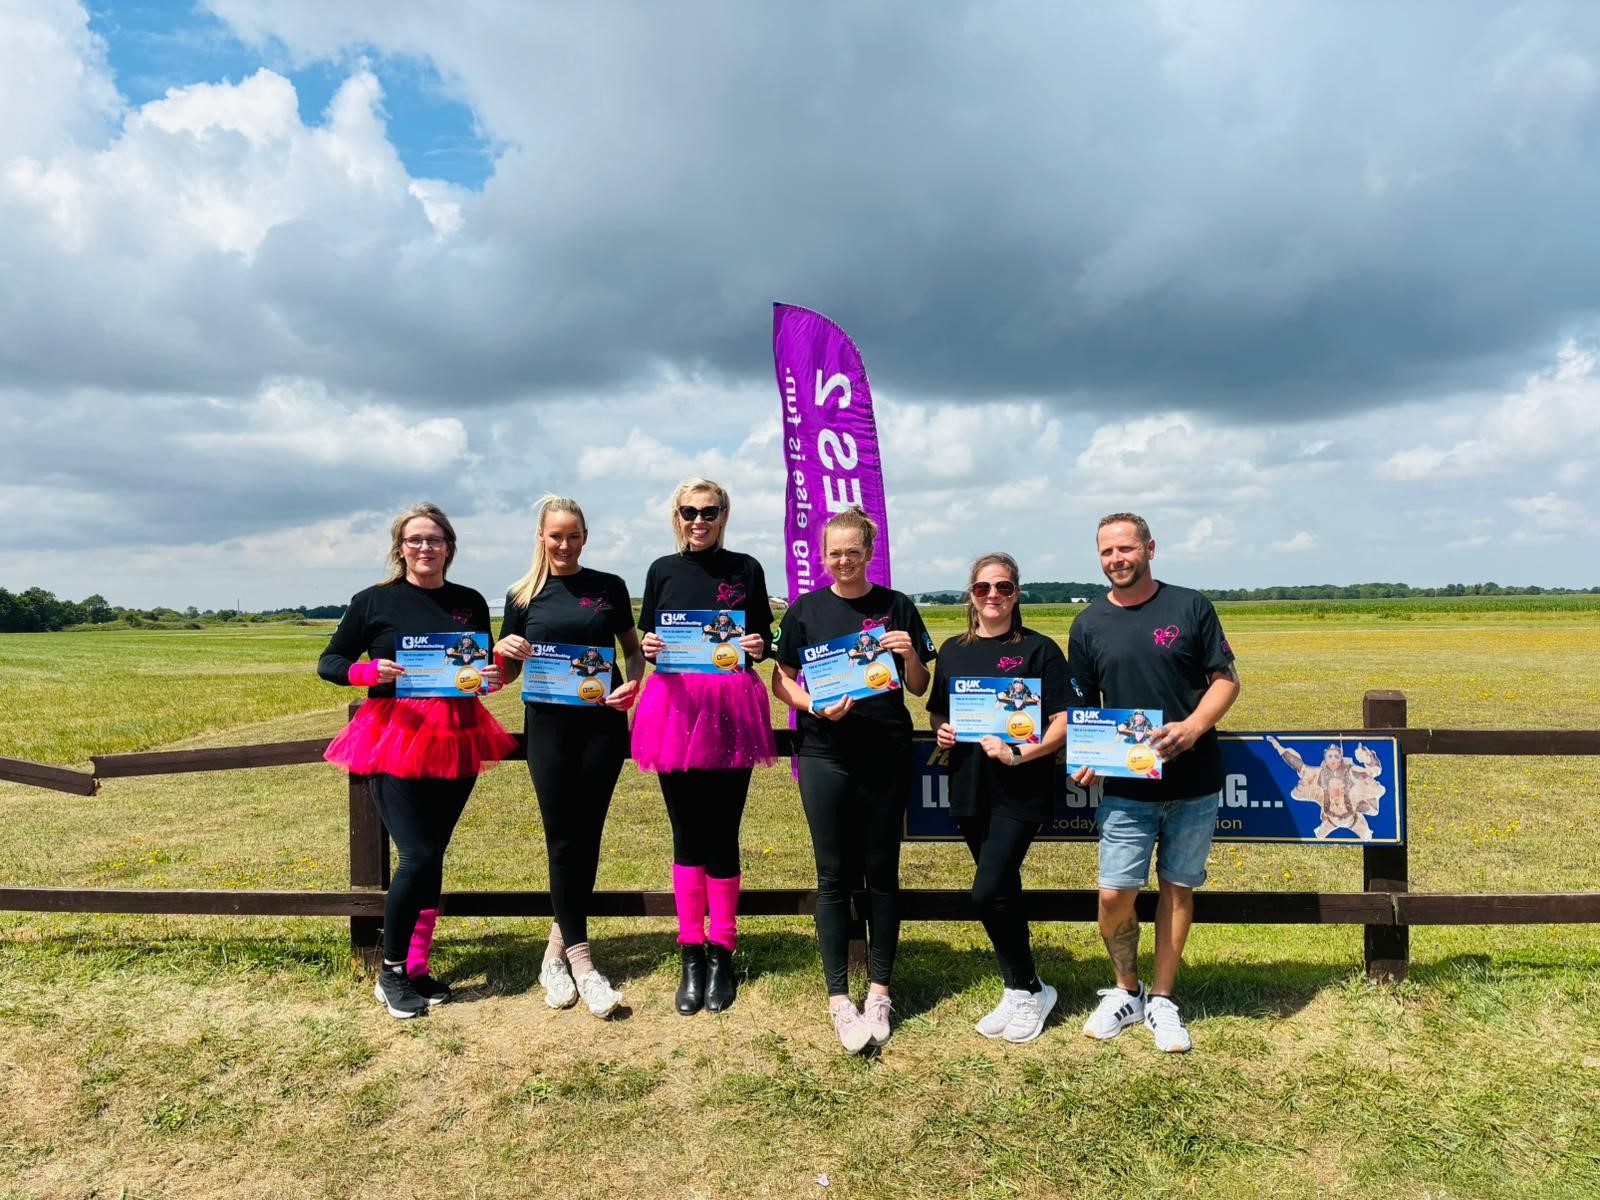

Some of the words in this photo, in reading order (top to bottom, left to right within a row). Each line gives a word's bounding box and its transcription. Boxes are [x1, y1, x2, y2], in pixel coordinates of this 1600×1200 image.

[672, 612, 687, 621] UK
[414, 636, 429, 644] UK
[542, 644, 557, 653] UK
[815, 643, 829, 654] UK
[966, 680, 981, 688] UK
[1084, 710, 1100, 719] UK
